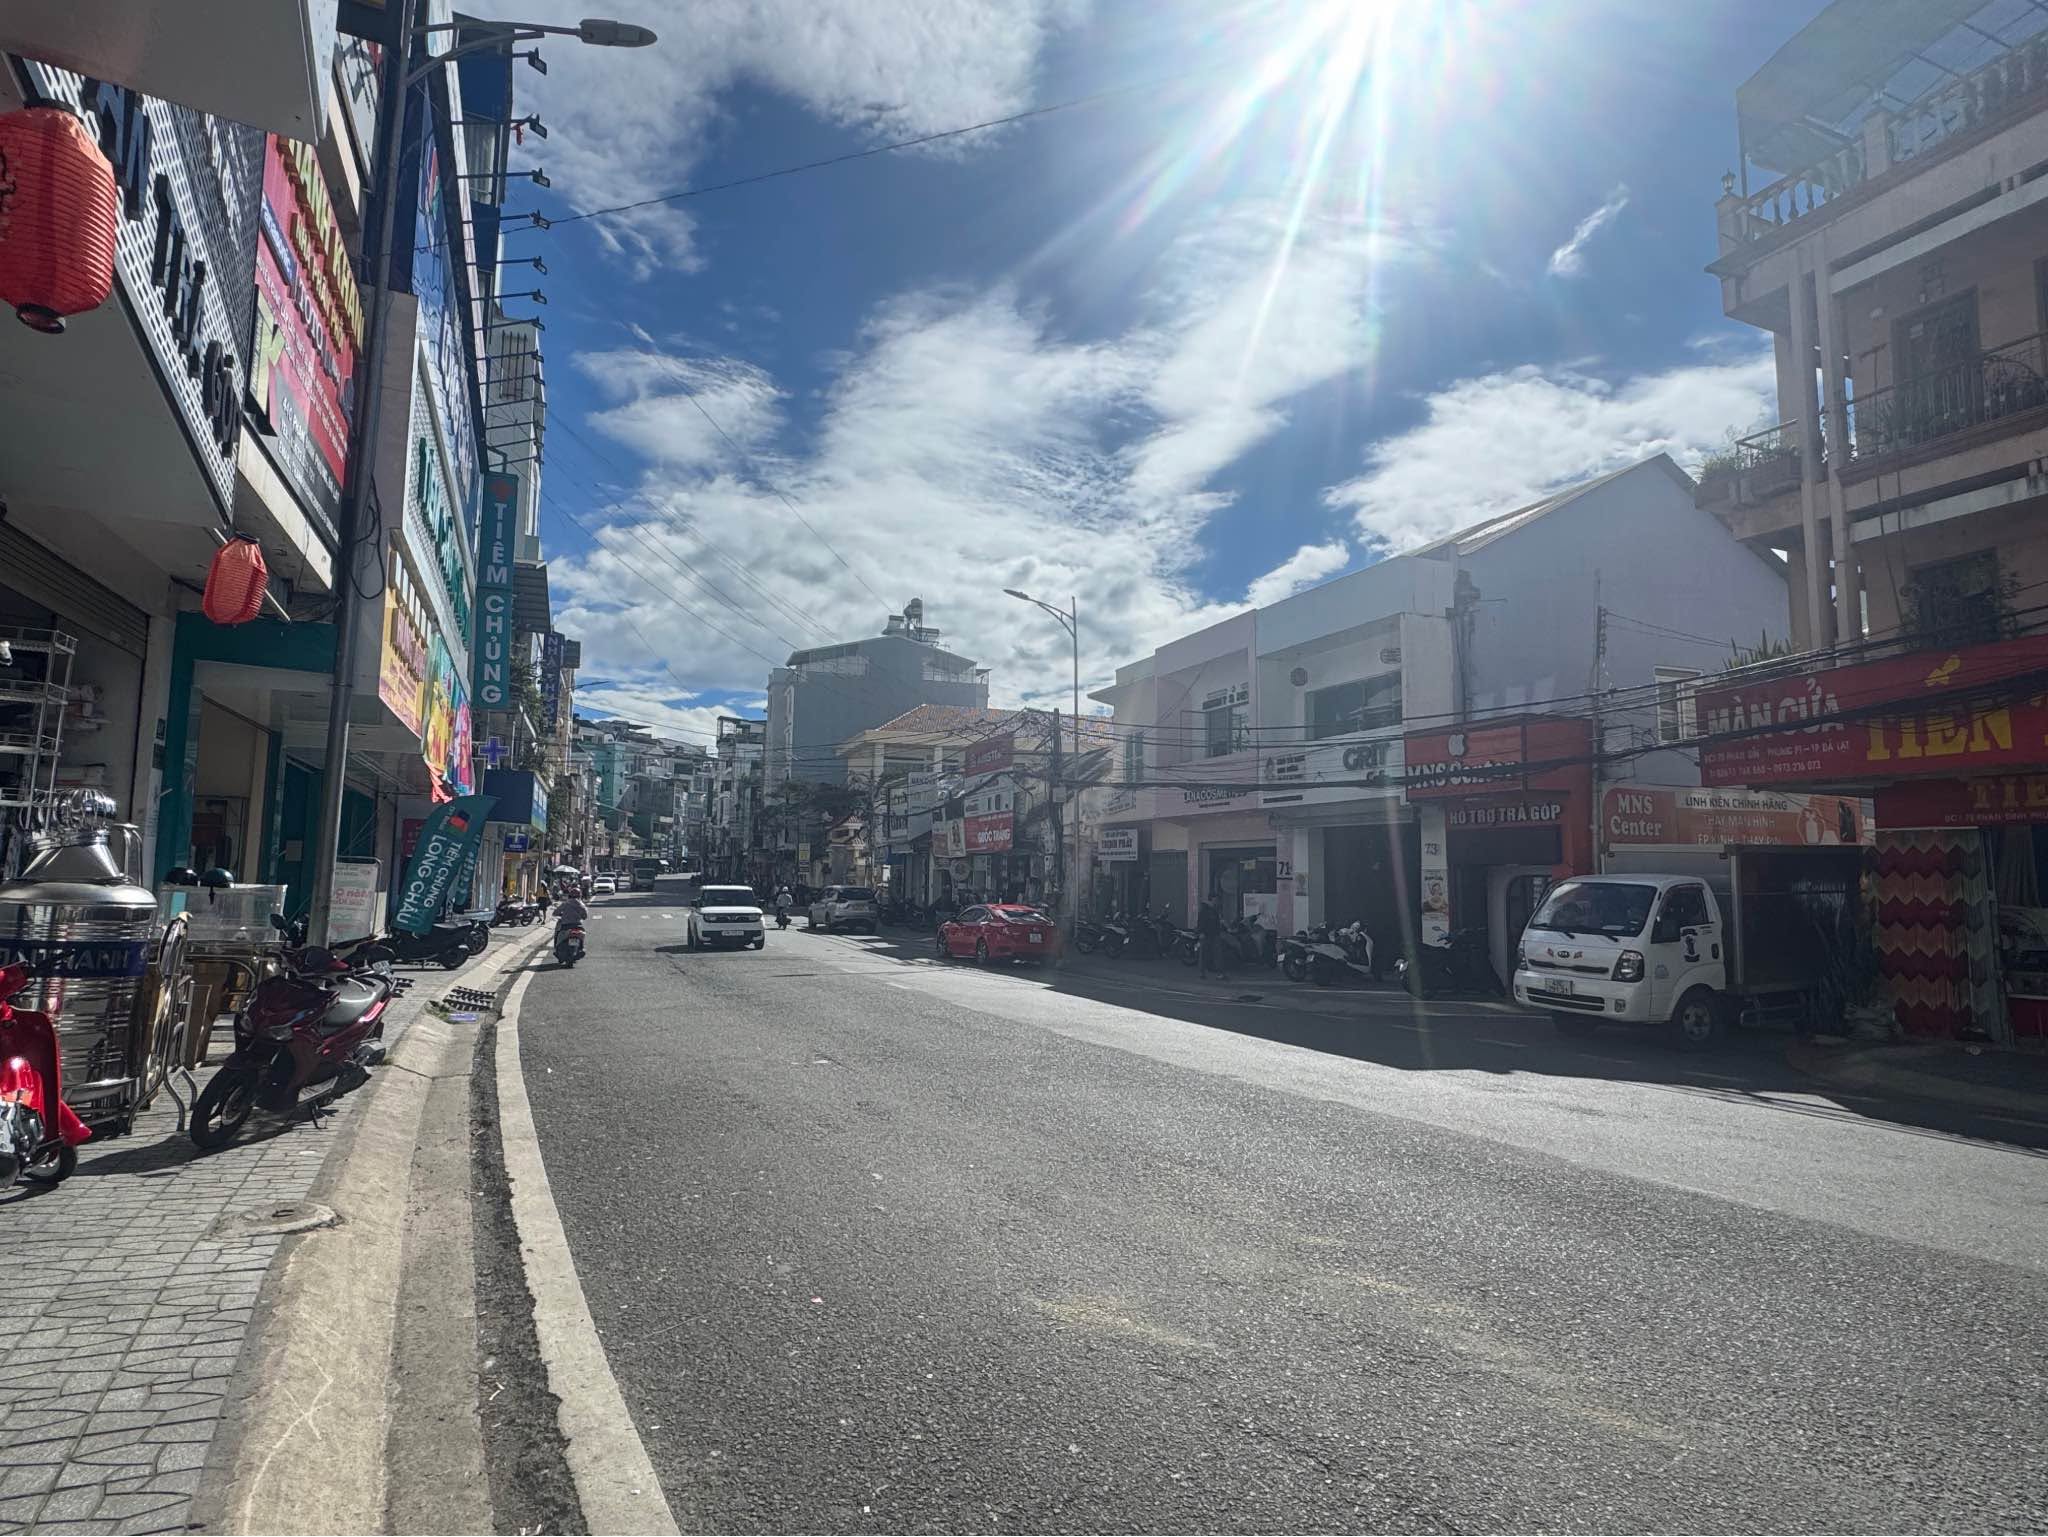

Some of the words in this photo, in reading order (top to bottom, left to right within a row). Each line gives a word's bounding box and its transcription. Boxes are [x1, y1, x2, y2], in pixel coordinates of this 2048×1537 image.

[486, 503, 508, 585] TIÊM
[481, 595, 505, 704] CHỦNG
[1617, 793, 1654, 814] MNS
[1685, 797, 1707, 808] LINH
[1610, 815, 1663, 837] Center
[417, 834, 448, 879] LONG
[397, 881, 426, 925] CHÂU
